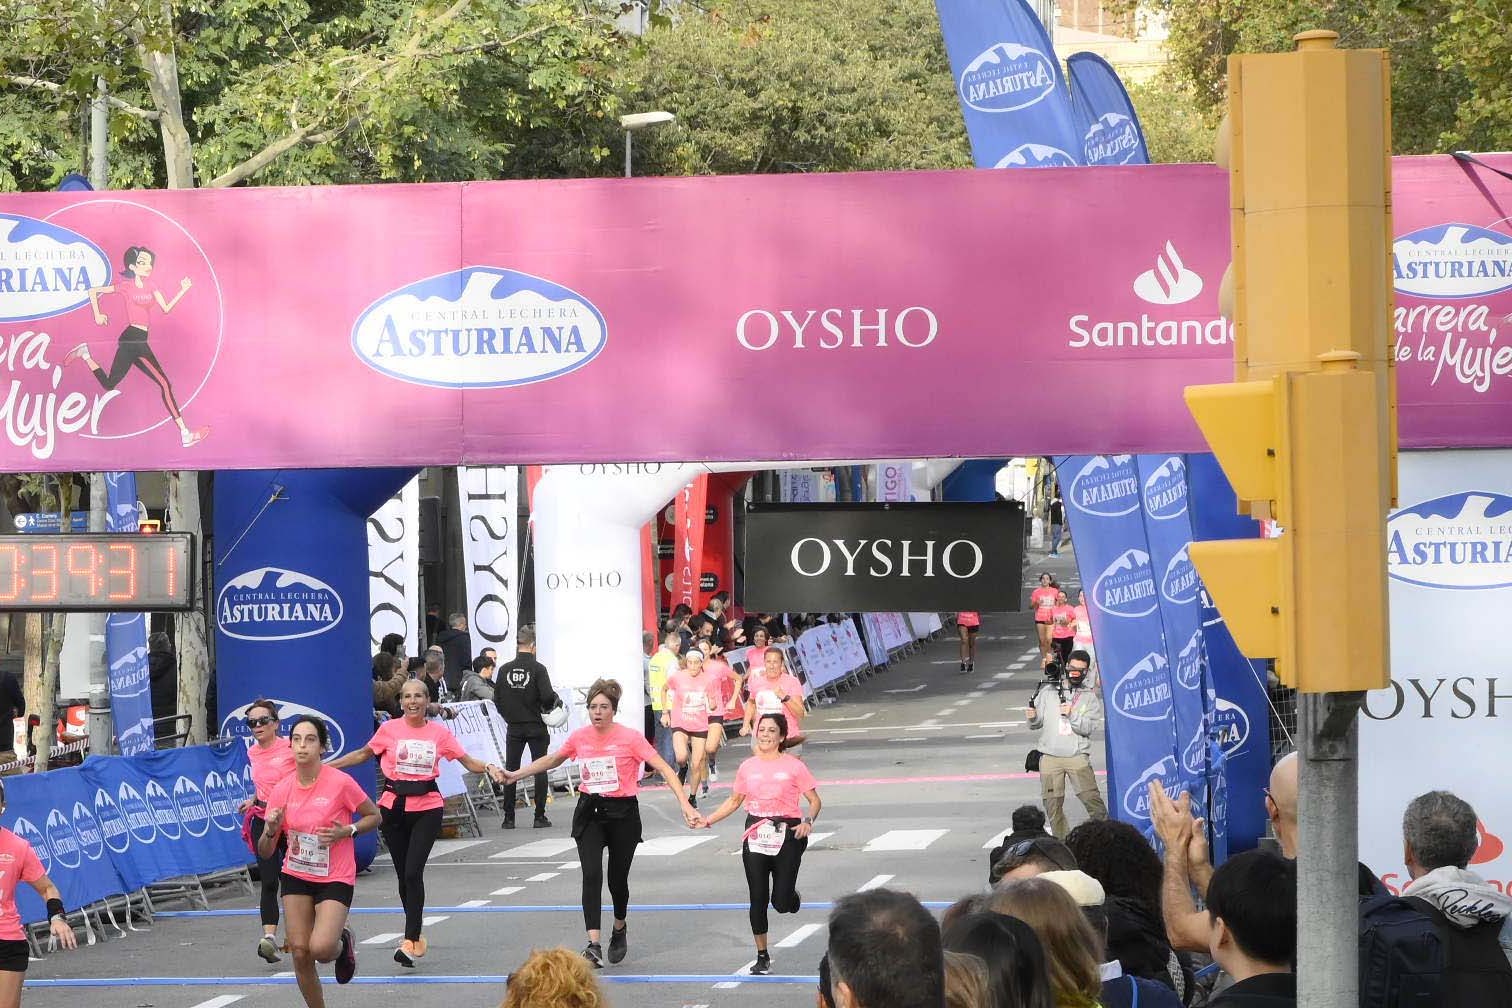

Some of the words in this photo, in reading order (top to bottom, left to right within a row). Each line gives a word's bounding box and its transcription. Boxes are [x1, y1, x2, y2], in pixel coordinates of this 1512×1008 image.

[14, 249, 87, 261] LECHERA
[1393, 251, 1512, 280] ASTURIAN
[1464, 247, 1512, 256] LECHER
[410, 309, 490, 322] CENTRAL
[497, 307, 579, 320] LECHERA
[735, 306, 939, 351] OYSHO
[1394, 304, 1490, 333] arrera
[371, 314, 587, 358] ASTURIANA
[1068, 315, 1233, 348] Santand
[1417, 334, 1436, 362] la
[1430, 328, 1512, 393] Muje
[1415, 526, 1481, 536] CENTRAL
[790, 537, 984, 578] OYSHO
[1387, 529, 1512, 566] ASTURI
[546, 571, 622, 591] OYSHO
[220, 594, 335, 624] ASTURIANA
[233, 592, 277, 601] CENTRAL
[280, 592, 330, 601] LECHERA
[512, 672, 525, 682] BP
